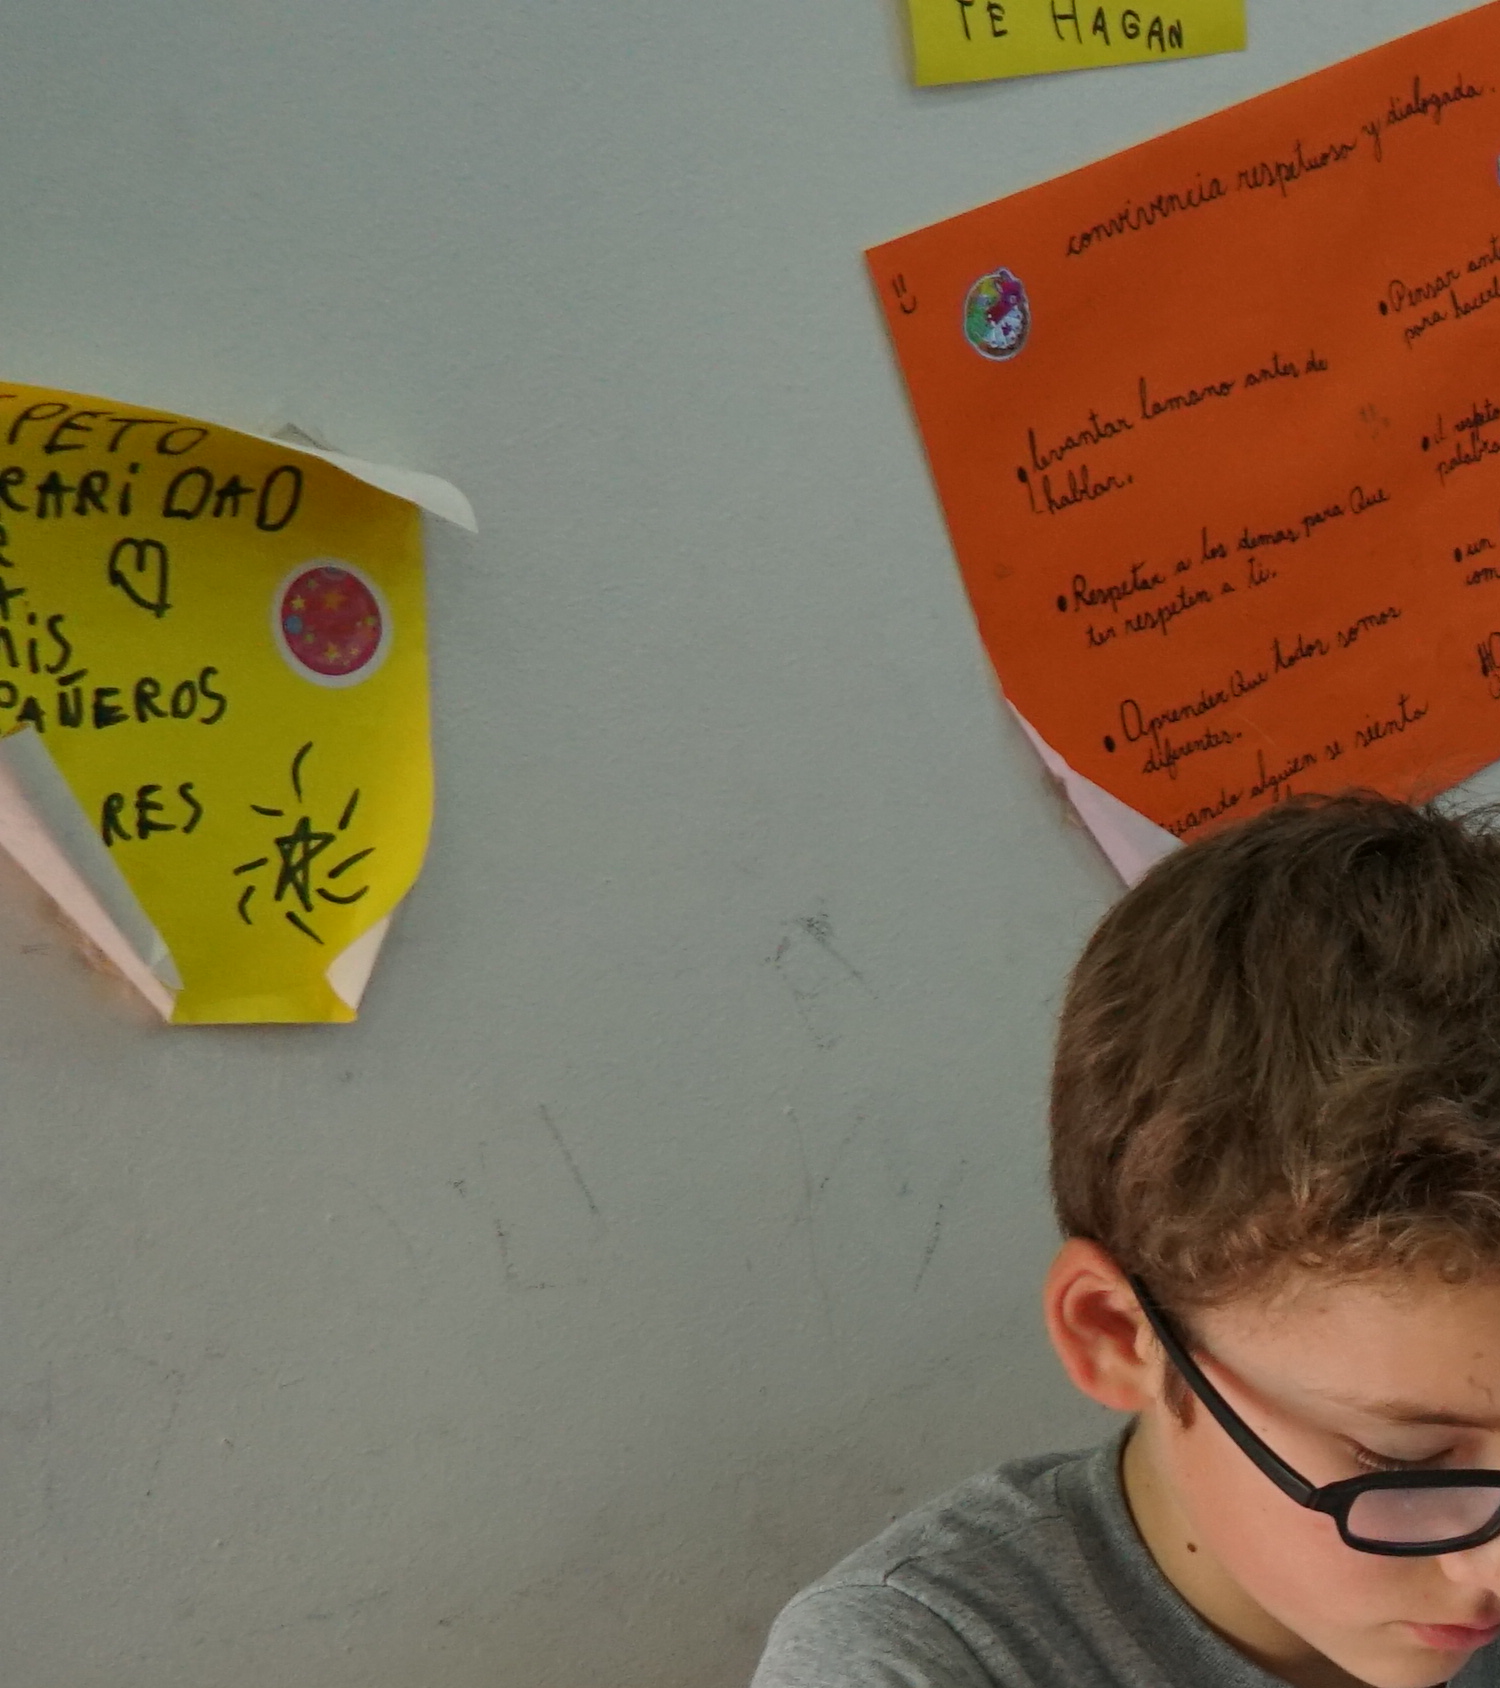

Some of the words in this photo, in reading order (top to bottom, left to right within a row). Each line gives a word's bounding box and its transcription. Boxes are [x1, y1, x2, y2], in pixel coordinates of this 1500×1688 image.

[956, 0, 1008, 41] TE
[1051, 0, 1184, 53] HAGAN
[1065, 172, 1228, 257] convivencia
[0, 402, 210, 458] PETO
[1158, 787, 1243, 838] uando
